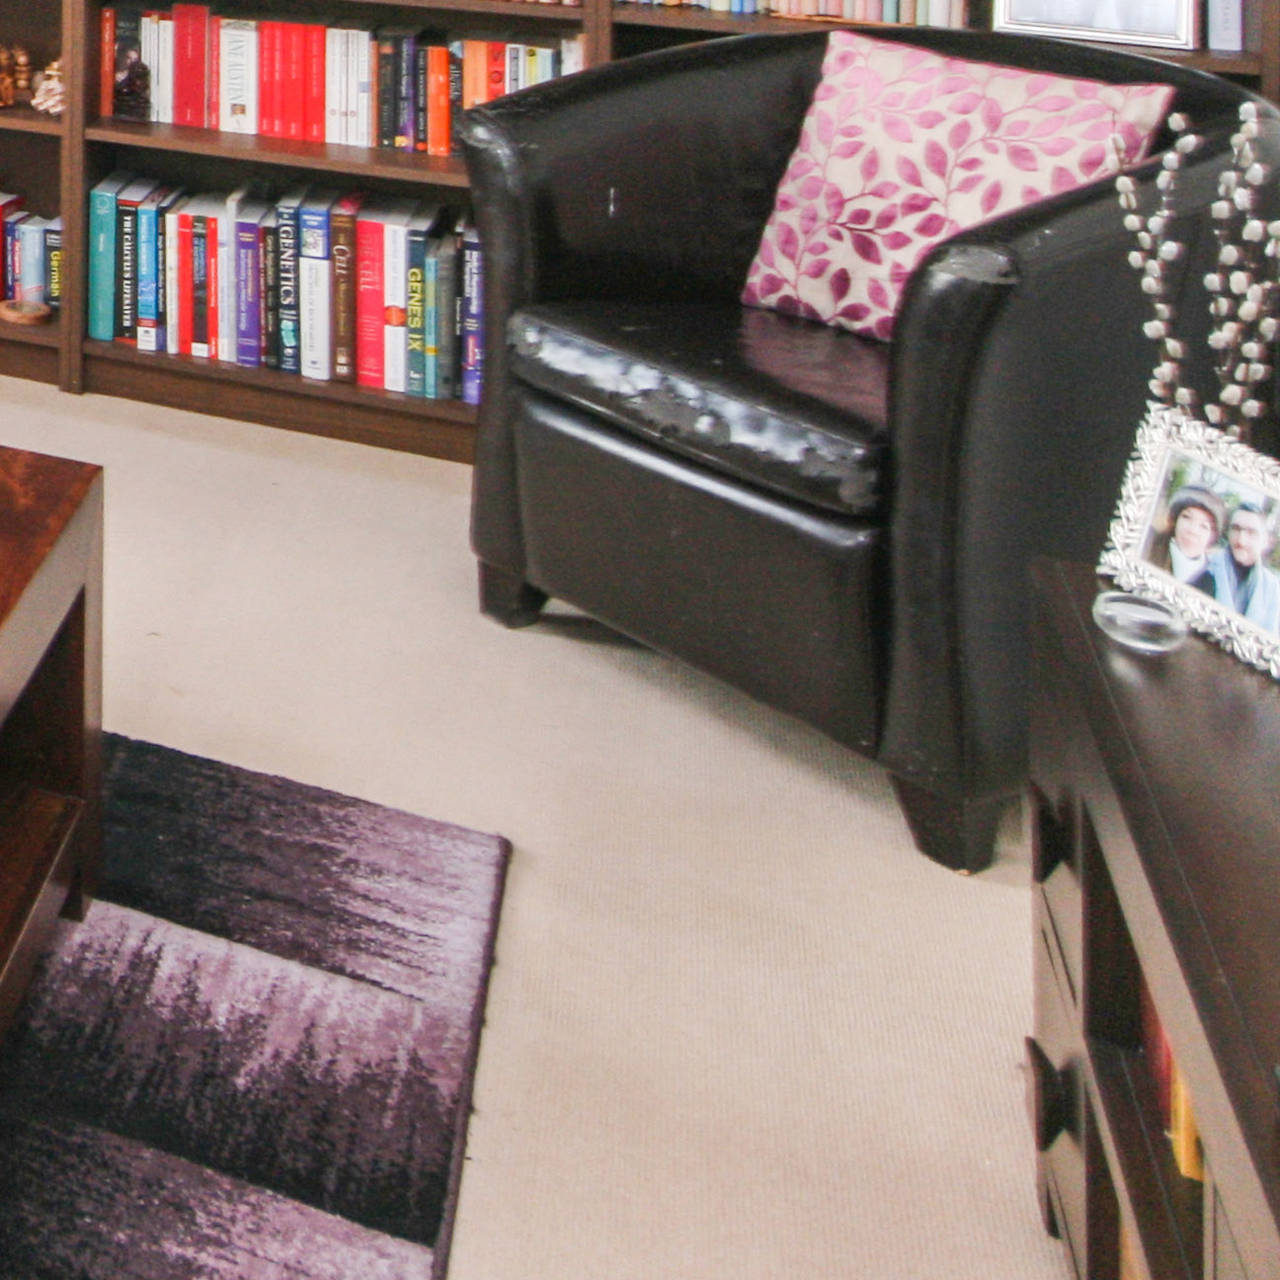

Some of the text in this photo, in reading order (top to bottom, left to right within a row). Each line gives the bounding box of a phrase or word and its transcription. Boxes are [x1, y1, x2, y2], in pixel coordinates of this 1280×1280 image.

[50, 250, 64, 297] German
[279, 226, 296, 305] GENETICS
[407, 267, 423, 352] GENES IX
